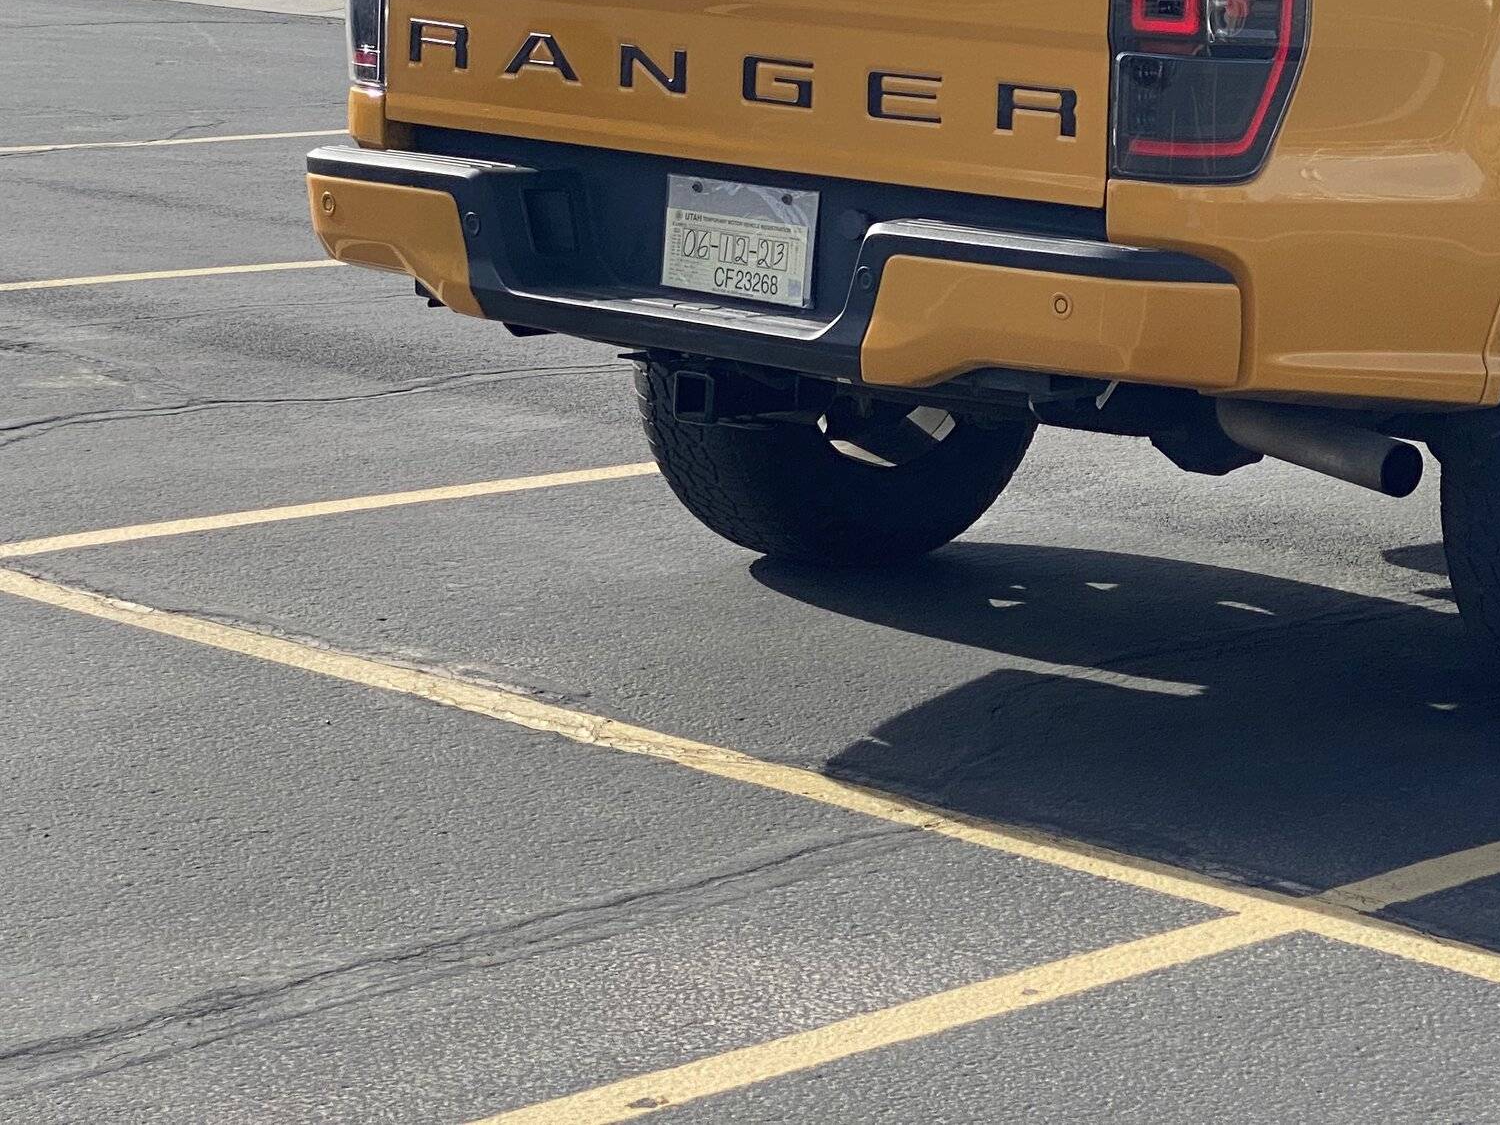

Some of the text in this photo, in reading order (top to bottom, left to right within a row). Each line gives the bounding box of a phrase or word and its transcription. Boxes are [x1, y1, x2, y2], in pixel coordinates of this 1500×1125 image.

[408, 17, 1078, 140] RANGER
[684, 212, 703, 222] UTAH
[682, 229, 785, 268] 06-12-23
[714, 267, 778, 296] CF23268
